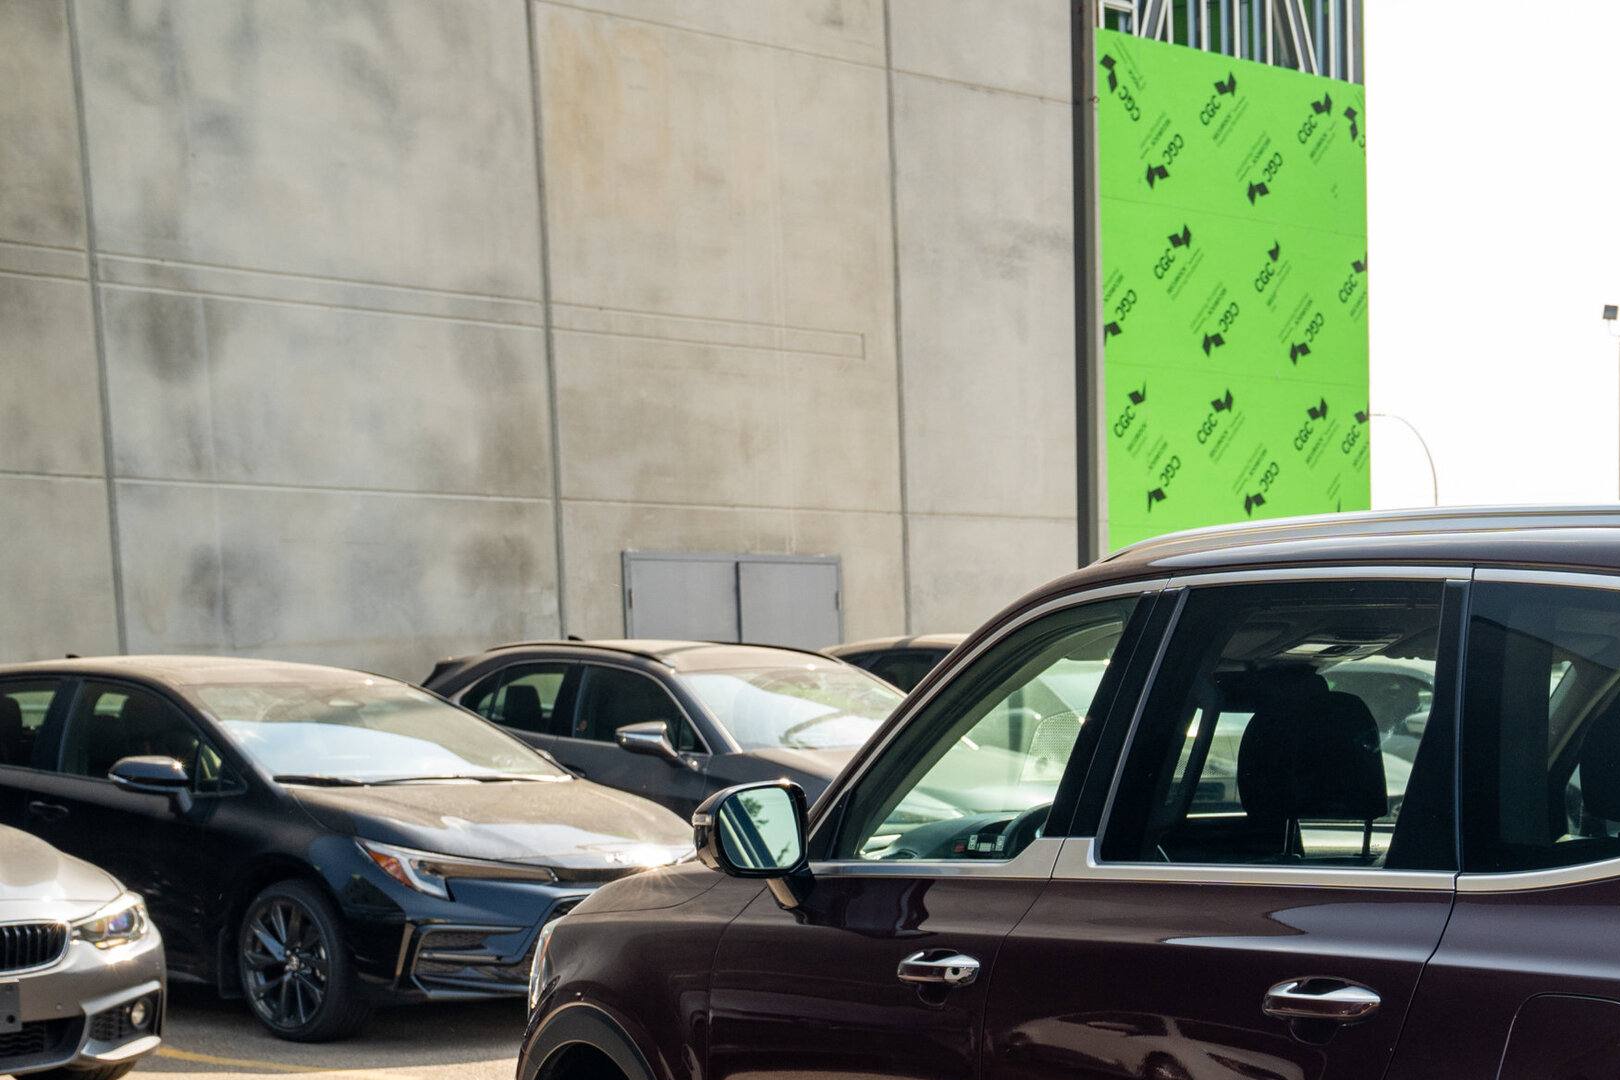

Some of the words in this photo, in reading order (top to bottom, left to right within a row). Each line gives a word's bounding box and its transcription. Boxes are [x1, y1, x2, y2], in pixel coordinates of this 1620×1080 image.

[1118, 86, 1140, 121] CGC
[1200, 95, 1221, 126] CGC
[1297, 115, 1318, 144] CGC
[1162, 134, 1184, 164] CGC
[1263, 153, 1283, 182] CGC
[1153, 248, 1176, 280] CGC
[1254, 262, 1275, 293] CGC
[1338, 274, 1358, 303] CGC
[1115, 289, 1138, 321] CGC
[1219, 302, 1240, 332] CGC
[1305, 312, 1325, 342] CGC
[1113, 406, 1136, 438] CGC
[1196, 413, 1218, 445] CGC
[1293, 421, 1314, 452] CGC
[1341, 425, 1361, 454] CGC
[1159, 455, 1182, 487] CGC
[1259, 461, 1280, 492] CGC
